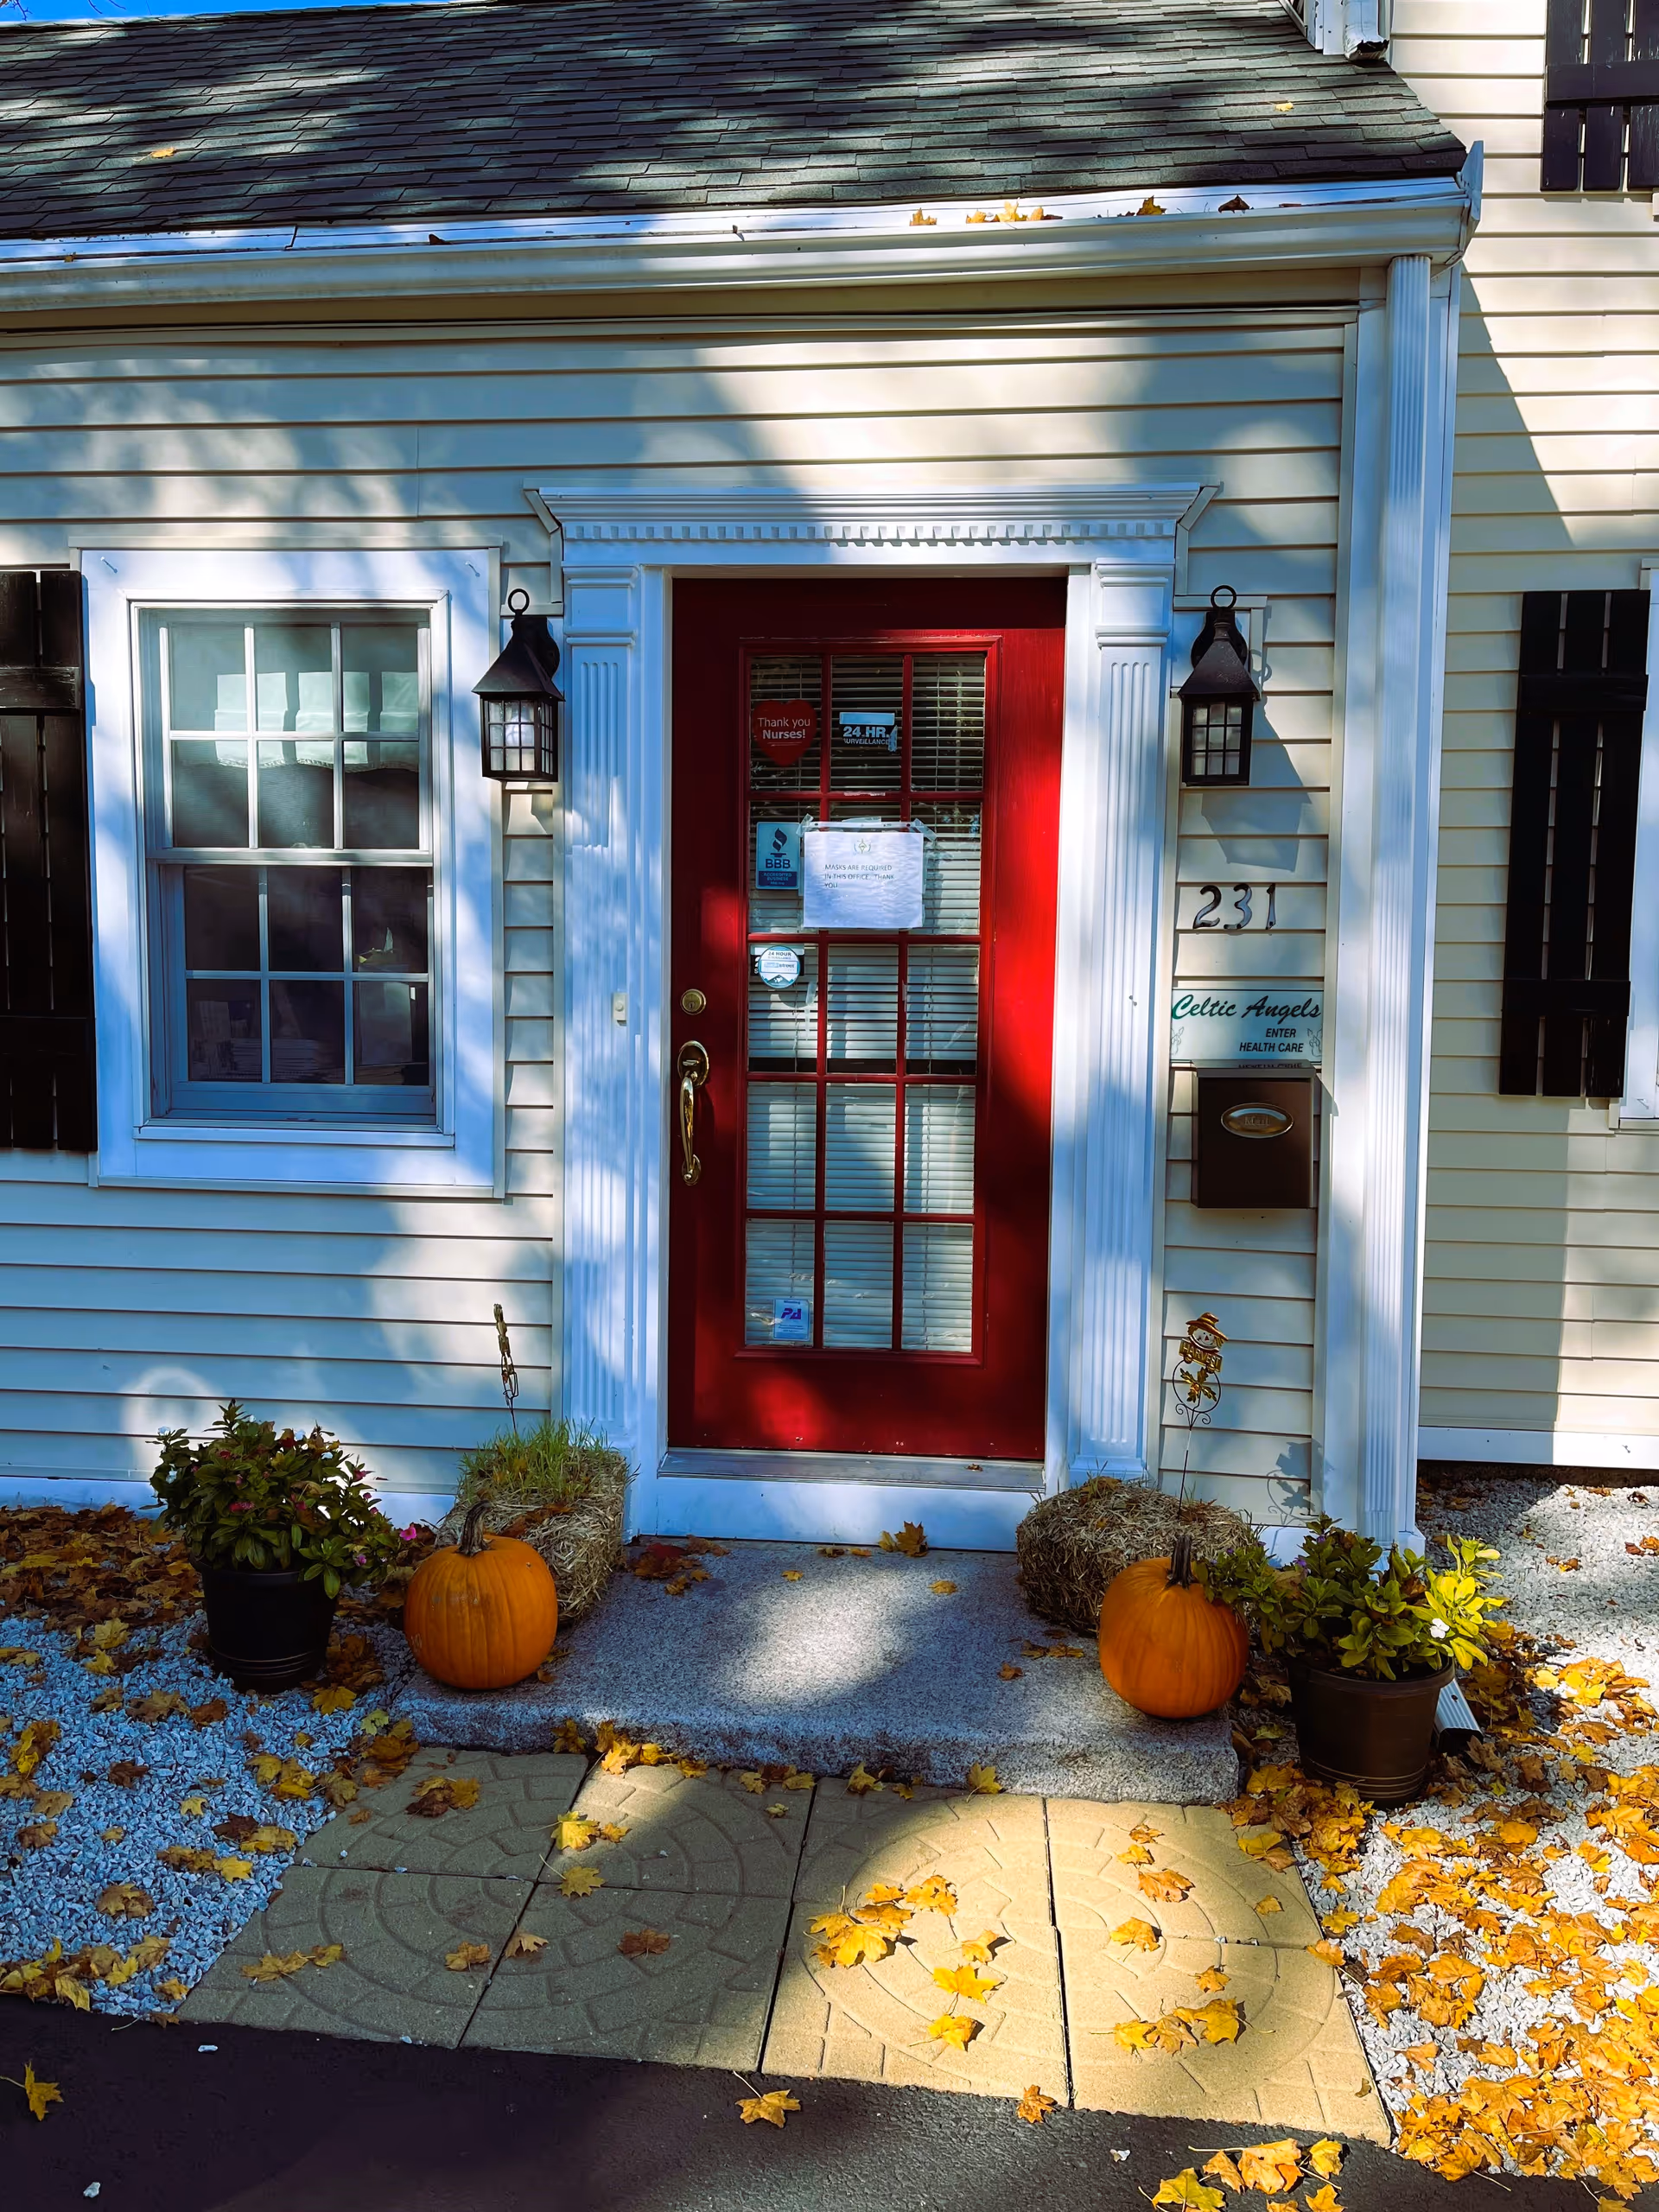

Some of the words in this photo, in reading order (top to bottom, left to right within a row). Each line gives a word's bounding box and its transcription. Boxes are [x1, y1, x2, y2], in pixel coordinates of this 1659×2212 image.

[757, 717, 789, 728] Thank
[791, 718, 810, 728] you
[762, 729, 806, 740] Nurses!
[842, 726, 861, 737] 24
[765, 858, 791, 869] BBB
[1192, 882, 1276, 931] 231
[1172, 994, 1237, 1020] Celtic
[1241, 995, 1322, 1025] Angels
[1265, 1027, 1297, 1039] ENTER
[1238, 1042, 1275, 1052] HEALTH
[1277, 1042, 1305, 1053] CARE
[1179, 1340, 1222, 1371] HARVEST
